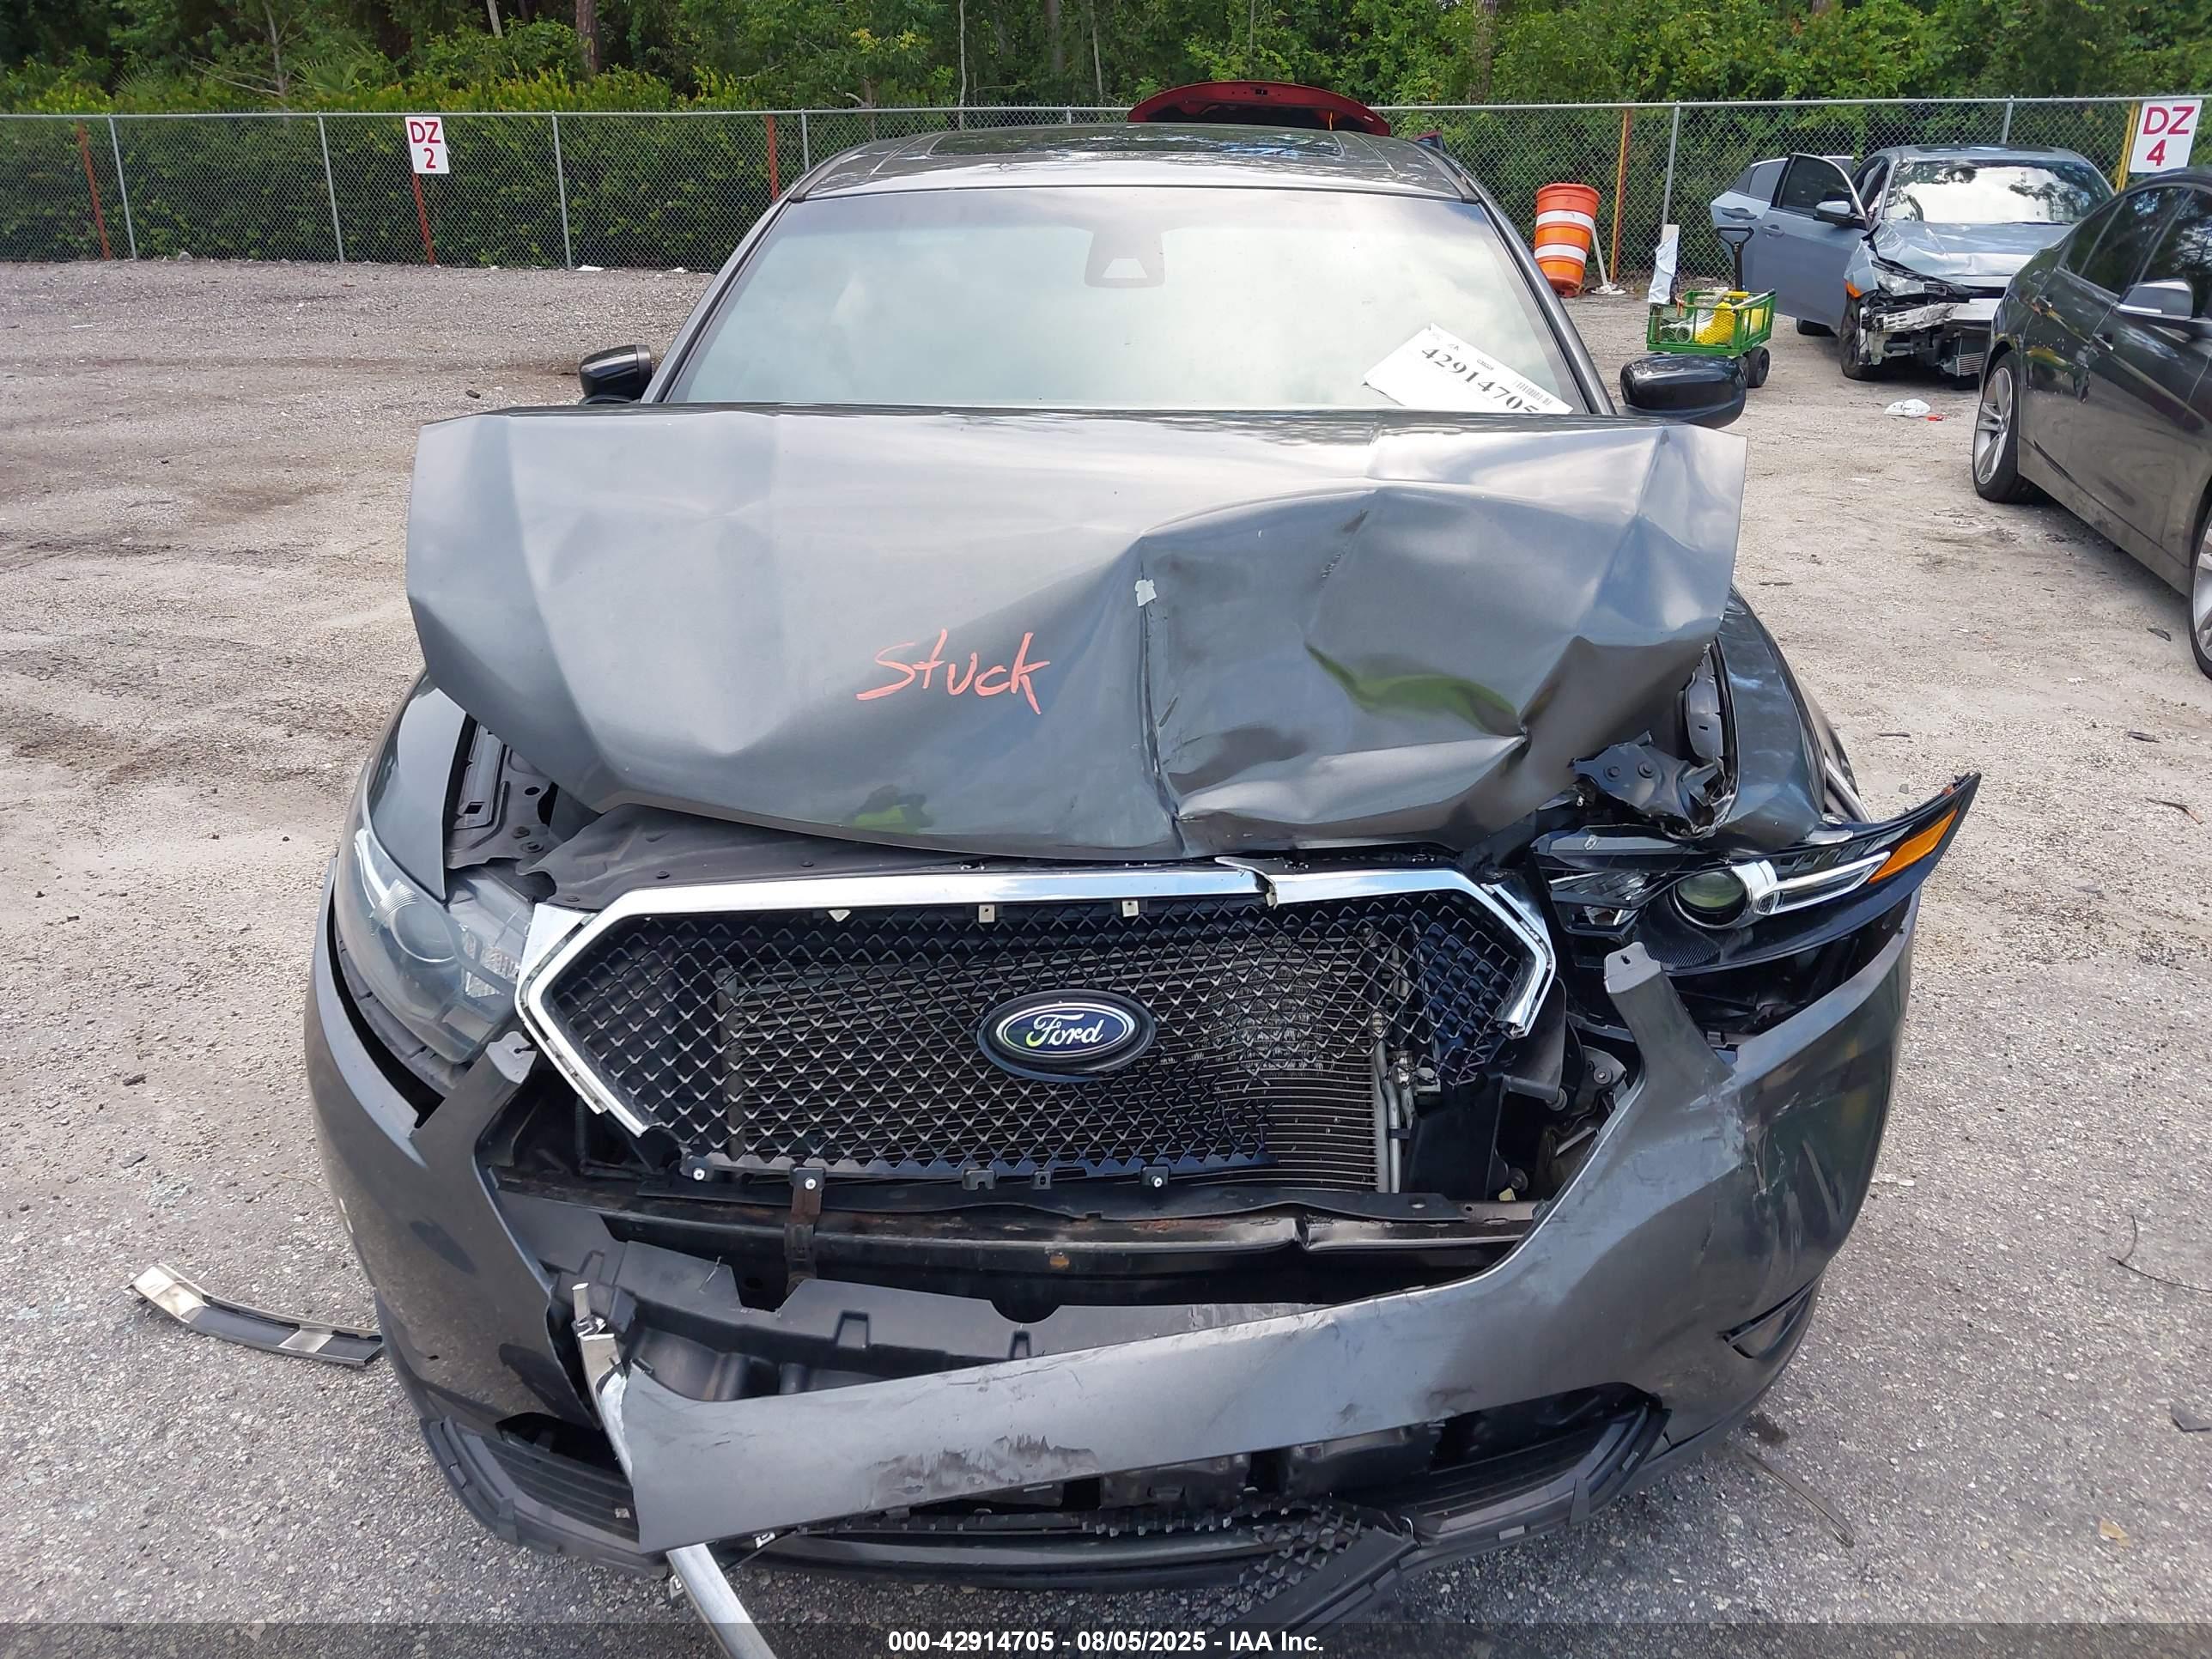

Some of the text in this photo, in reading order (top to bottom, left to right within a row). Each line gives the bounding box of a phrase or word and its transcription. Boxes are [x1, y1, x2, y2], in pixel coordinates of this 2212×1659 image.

[409, 121, 441, 143] DZ
[2142, 106, 2196, 135] DZ
[422, 147, 436, 168] 2
[2146, 138, 2166, 167] 4
[1025, 1012, 1105, 1048] Ford
